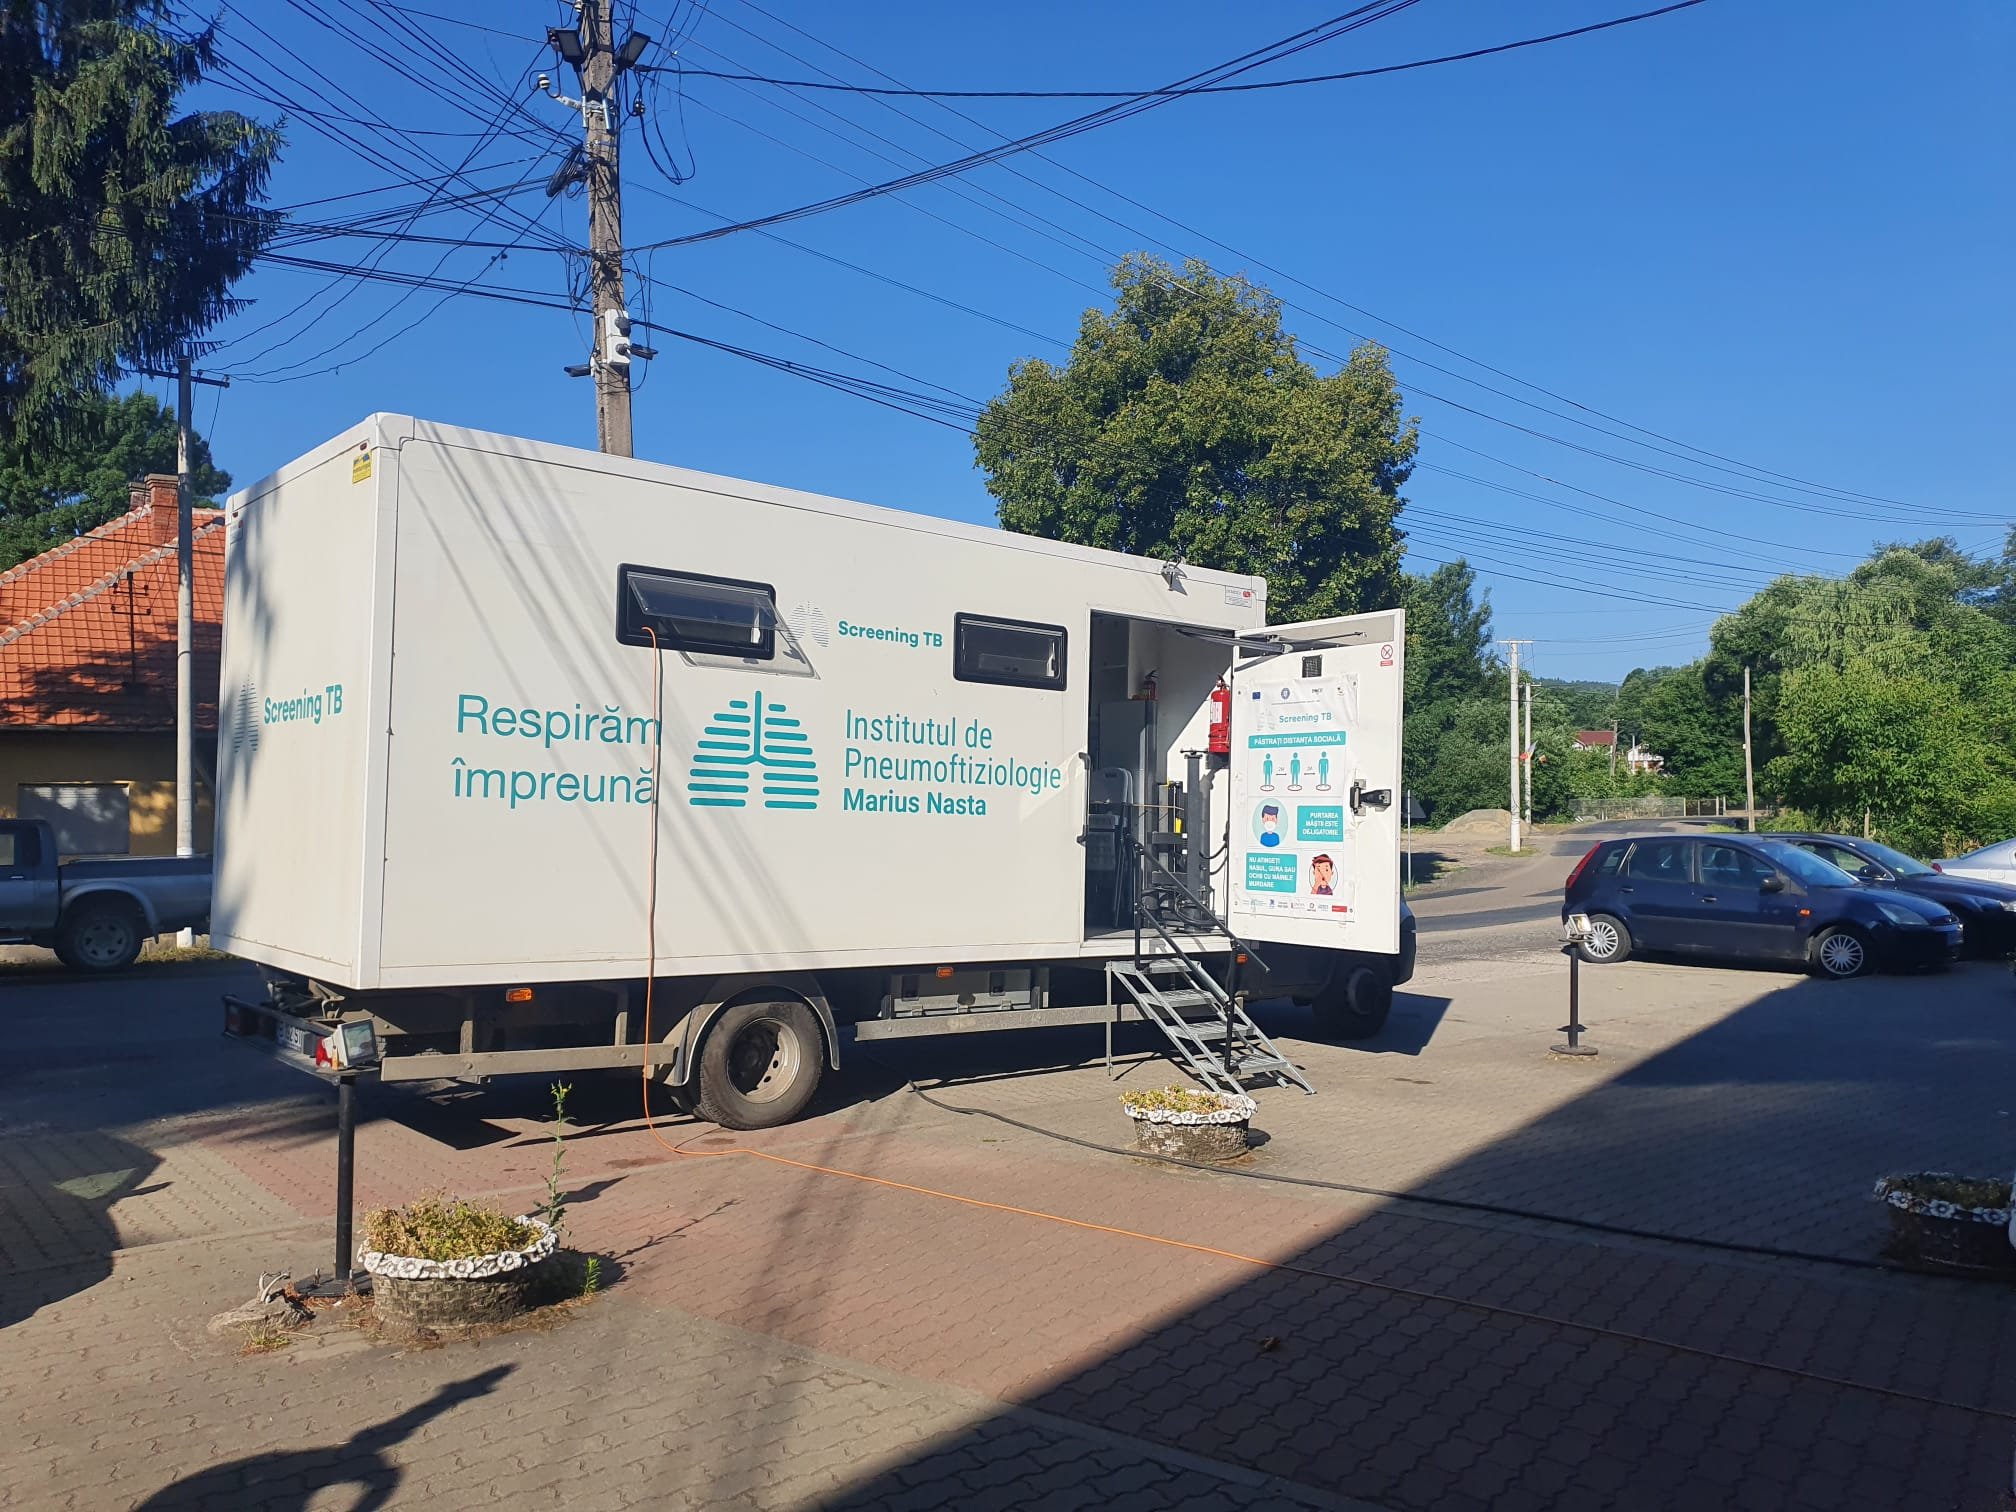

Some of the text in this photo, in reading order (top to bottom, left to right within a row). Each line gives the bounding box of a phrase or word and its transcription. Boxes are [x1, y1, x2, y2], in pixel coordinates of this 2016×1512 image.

[838, 620, 943, 648] Screening TB
[264, 683, 342, 724] Screening TB
[457, 694, 662, 749] Respirăm
[1279, 714, 1318, 723] Screening
[1321, 712, 1332, 720] TB
[846, 709, 992, 749] Institutul de
[451, 757, 657, 809] împreună
[845, 747, 1061, 794] Pneumoftiziologie
[843, 788, 986, 815] Marius Nasta
